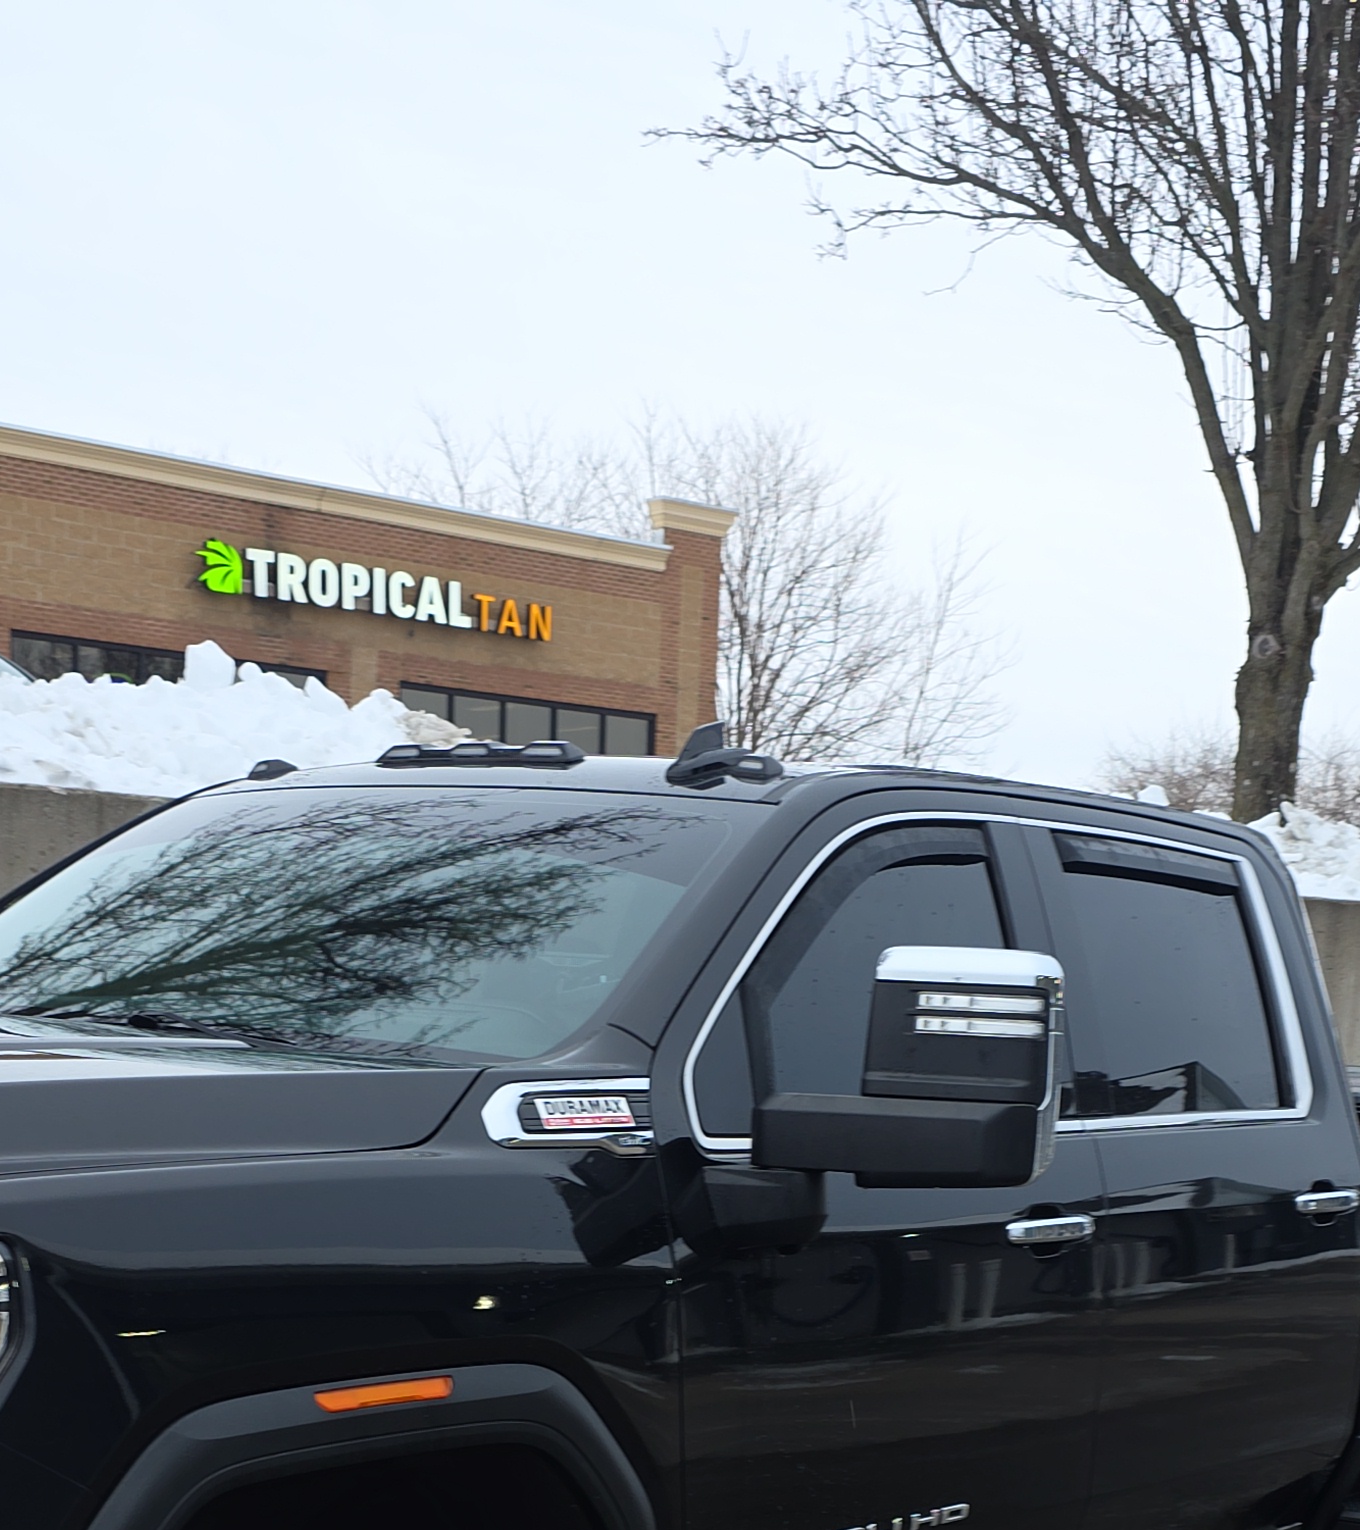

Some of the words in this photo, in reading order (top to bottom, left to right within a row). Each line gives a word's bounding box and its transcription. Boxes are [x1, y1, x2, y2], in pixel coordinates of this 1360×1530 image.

[245, 547, 473, 629] TROPICAL
[473, 593, 552, 642] TAN
[542, 1100, 626, 1116] DURAMAX
[909, 1502, 970, 1530] HD
